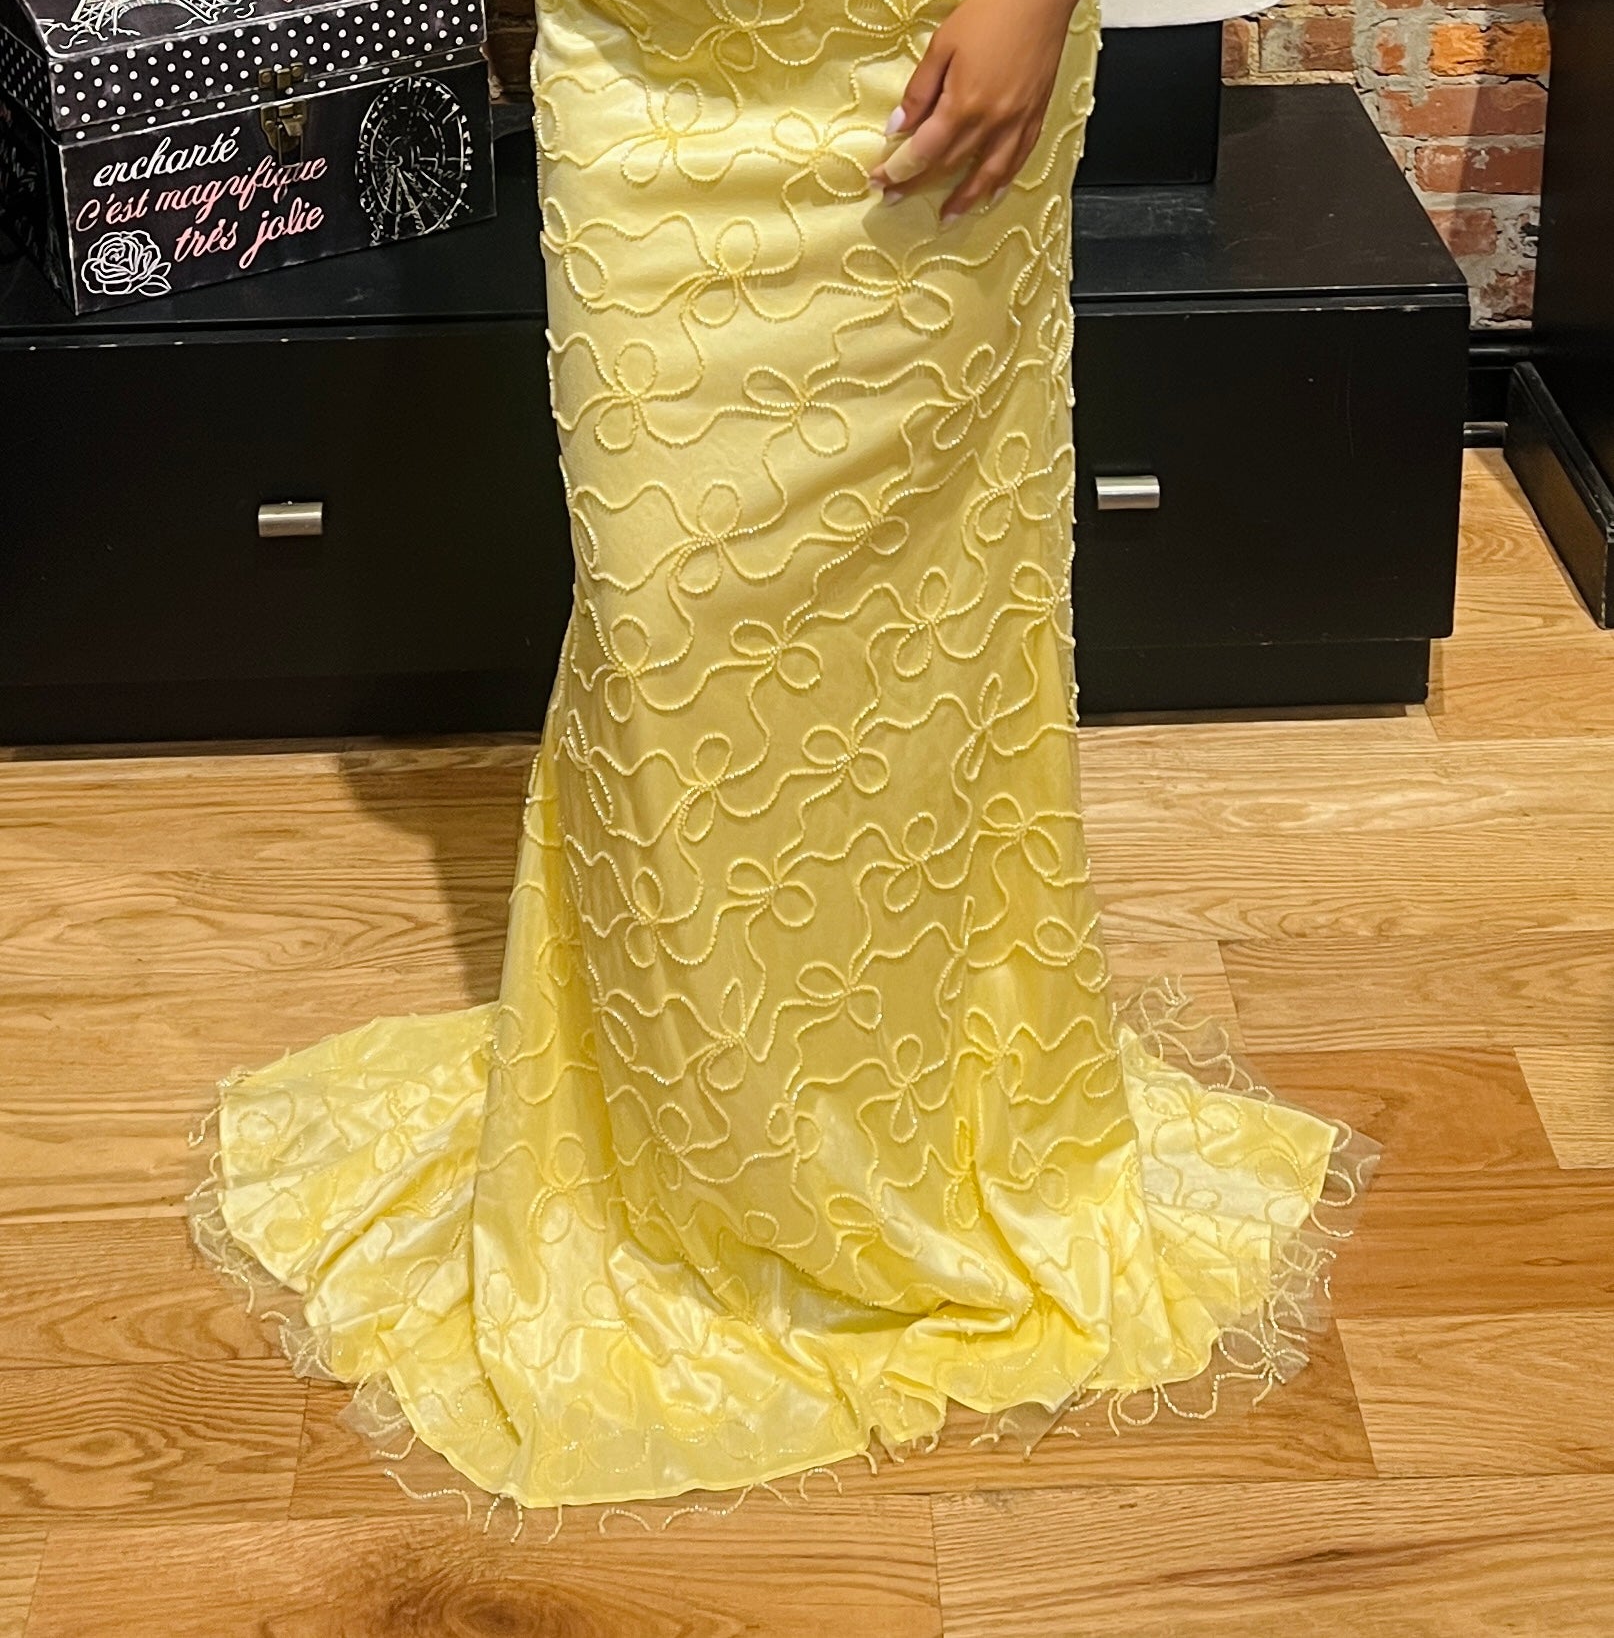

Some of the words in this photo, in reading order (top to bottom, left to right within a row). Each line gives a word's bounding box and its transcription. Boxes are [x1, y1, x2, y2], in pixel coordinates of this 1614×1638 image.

[93, 126, 241, 187] enchanté
[75, 188, 149, 232] C'est
[154, 155, 328, 225] magnifique
[239, 197, 325, 270] jolie
